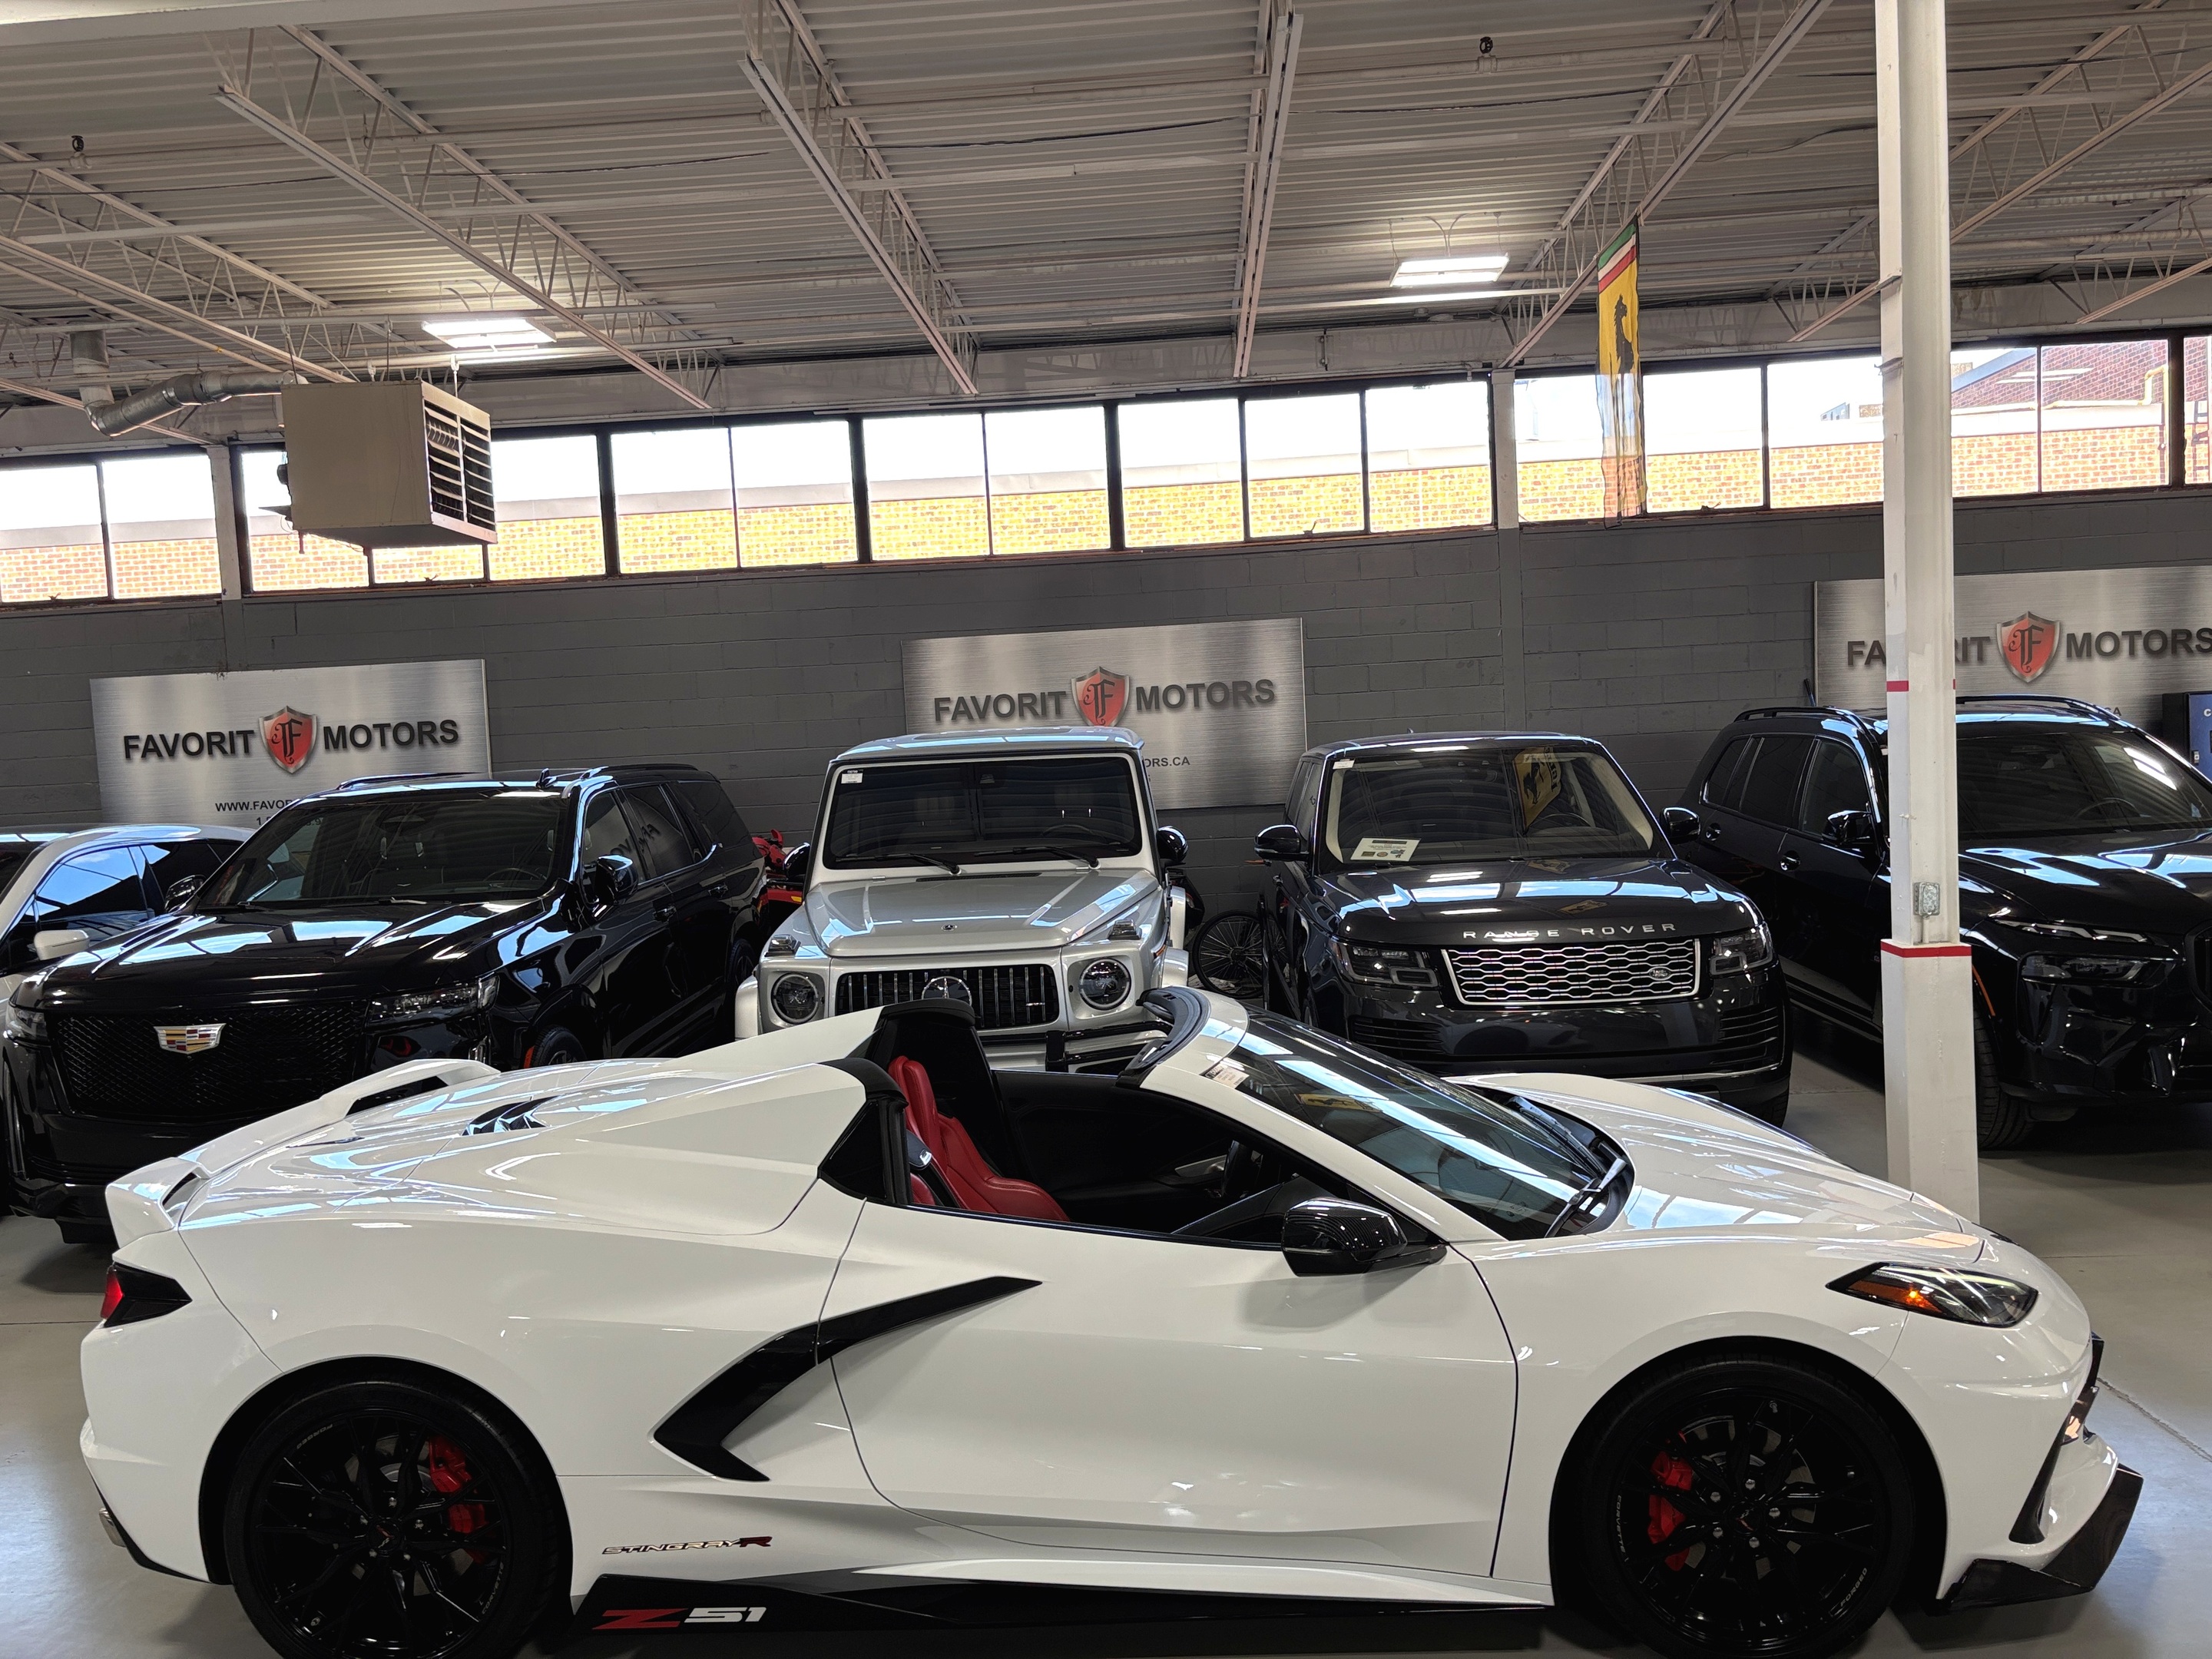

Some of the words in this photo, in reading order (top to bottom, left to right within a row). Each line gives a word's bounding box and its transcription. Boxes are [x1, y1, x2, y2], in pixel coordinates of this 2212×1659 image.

[1848, 637, 1991, 666] FAIT
[2067, 628, 2212, 658] MOTORS
[934, 690, 1067, 722] FAVORIT
[1136, 678, 1276, 711] MOTORS
[123, 729, 254, 760] FAVORIT
[323, 719, 459, 750] MOTORS
[1144, 756, 1190, 767] ORS.CA
[1462, 929, 1560, 939] RANGE
[1581, 923, 1677, 935] ROVER
[601, 1539, 740, 1555] STINGRAY
[1840, 1567, 1868, 1608] FORGED
[591, 1606, 767, 1631] Z51
